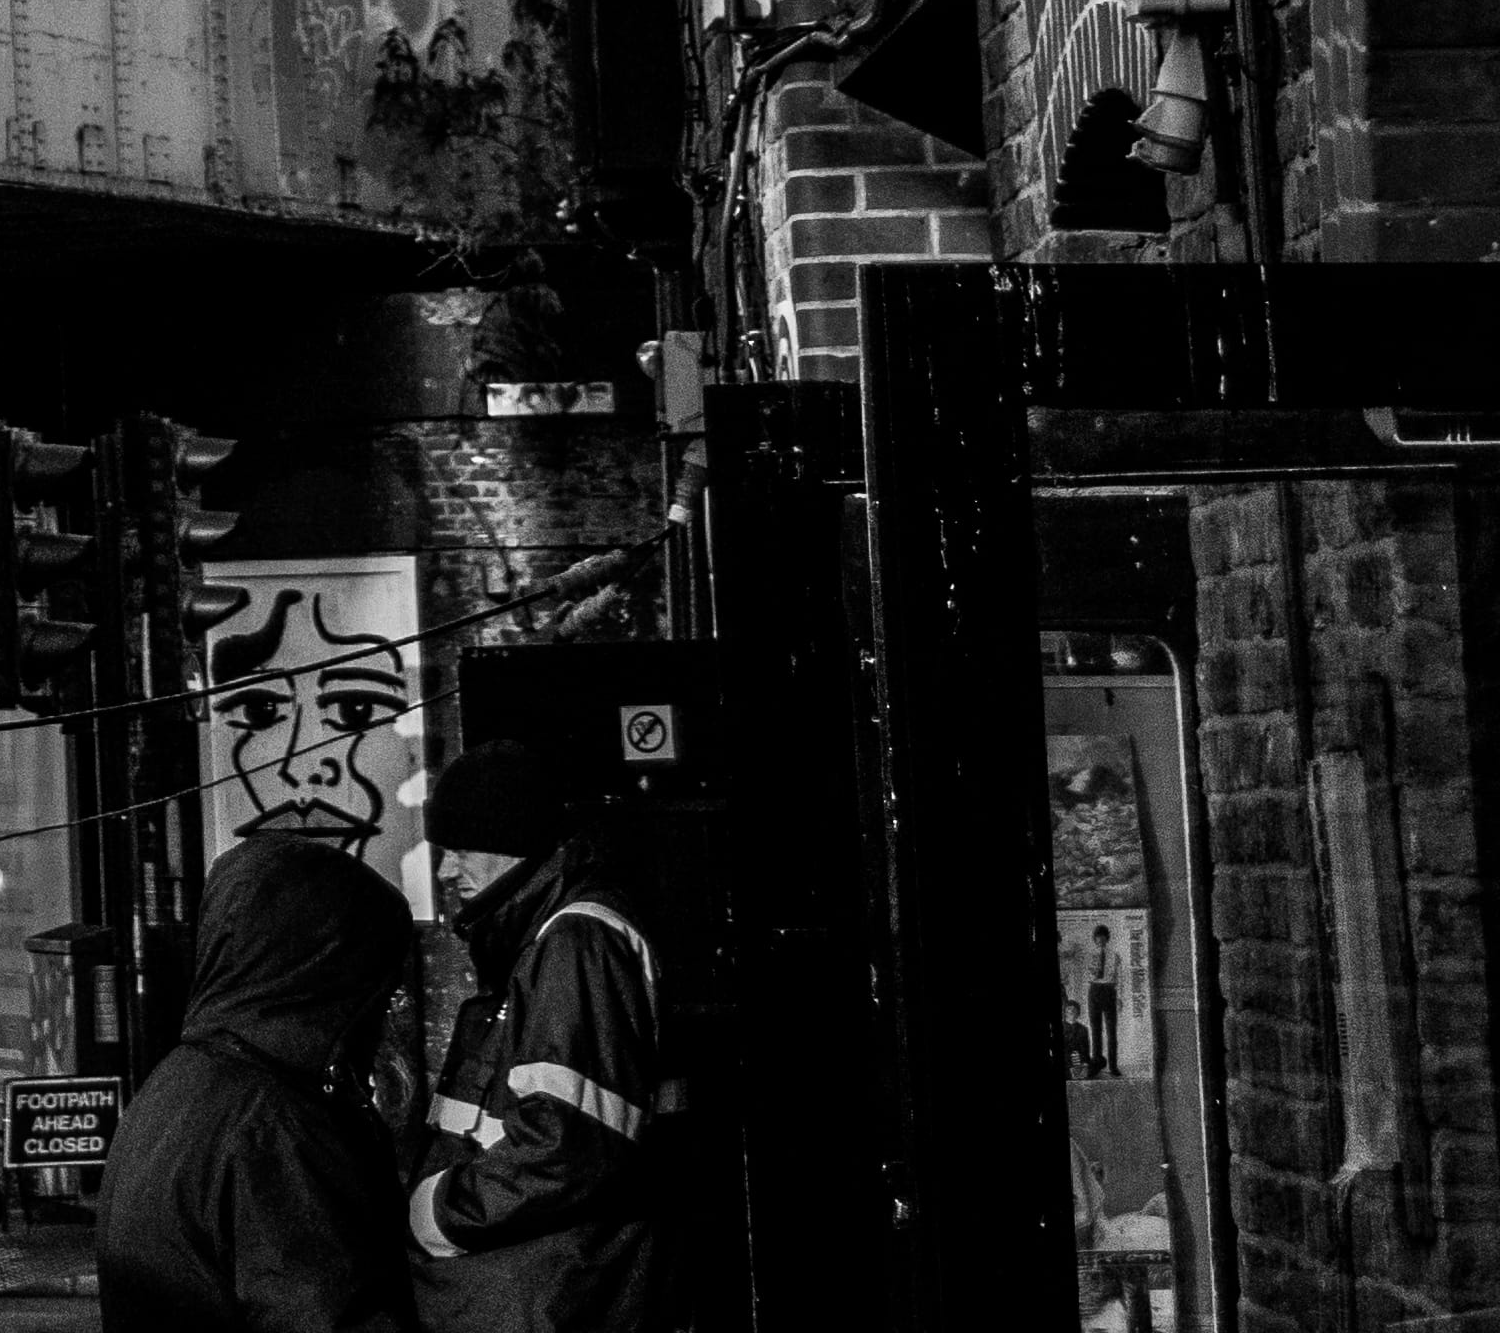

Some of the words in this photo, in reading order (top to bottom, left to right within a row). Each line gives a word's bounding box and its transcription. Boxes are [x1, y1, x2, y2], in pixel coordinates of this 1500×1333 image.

[15, 1090, 115, 1111] FOOTPATH
[30, 1113, 100, 1132] AHEAD
[23, 1136, 105, 1155] CLOSED
